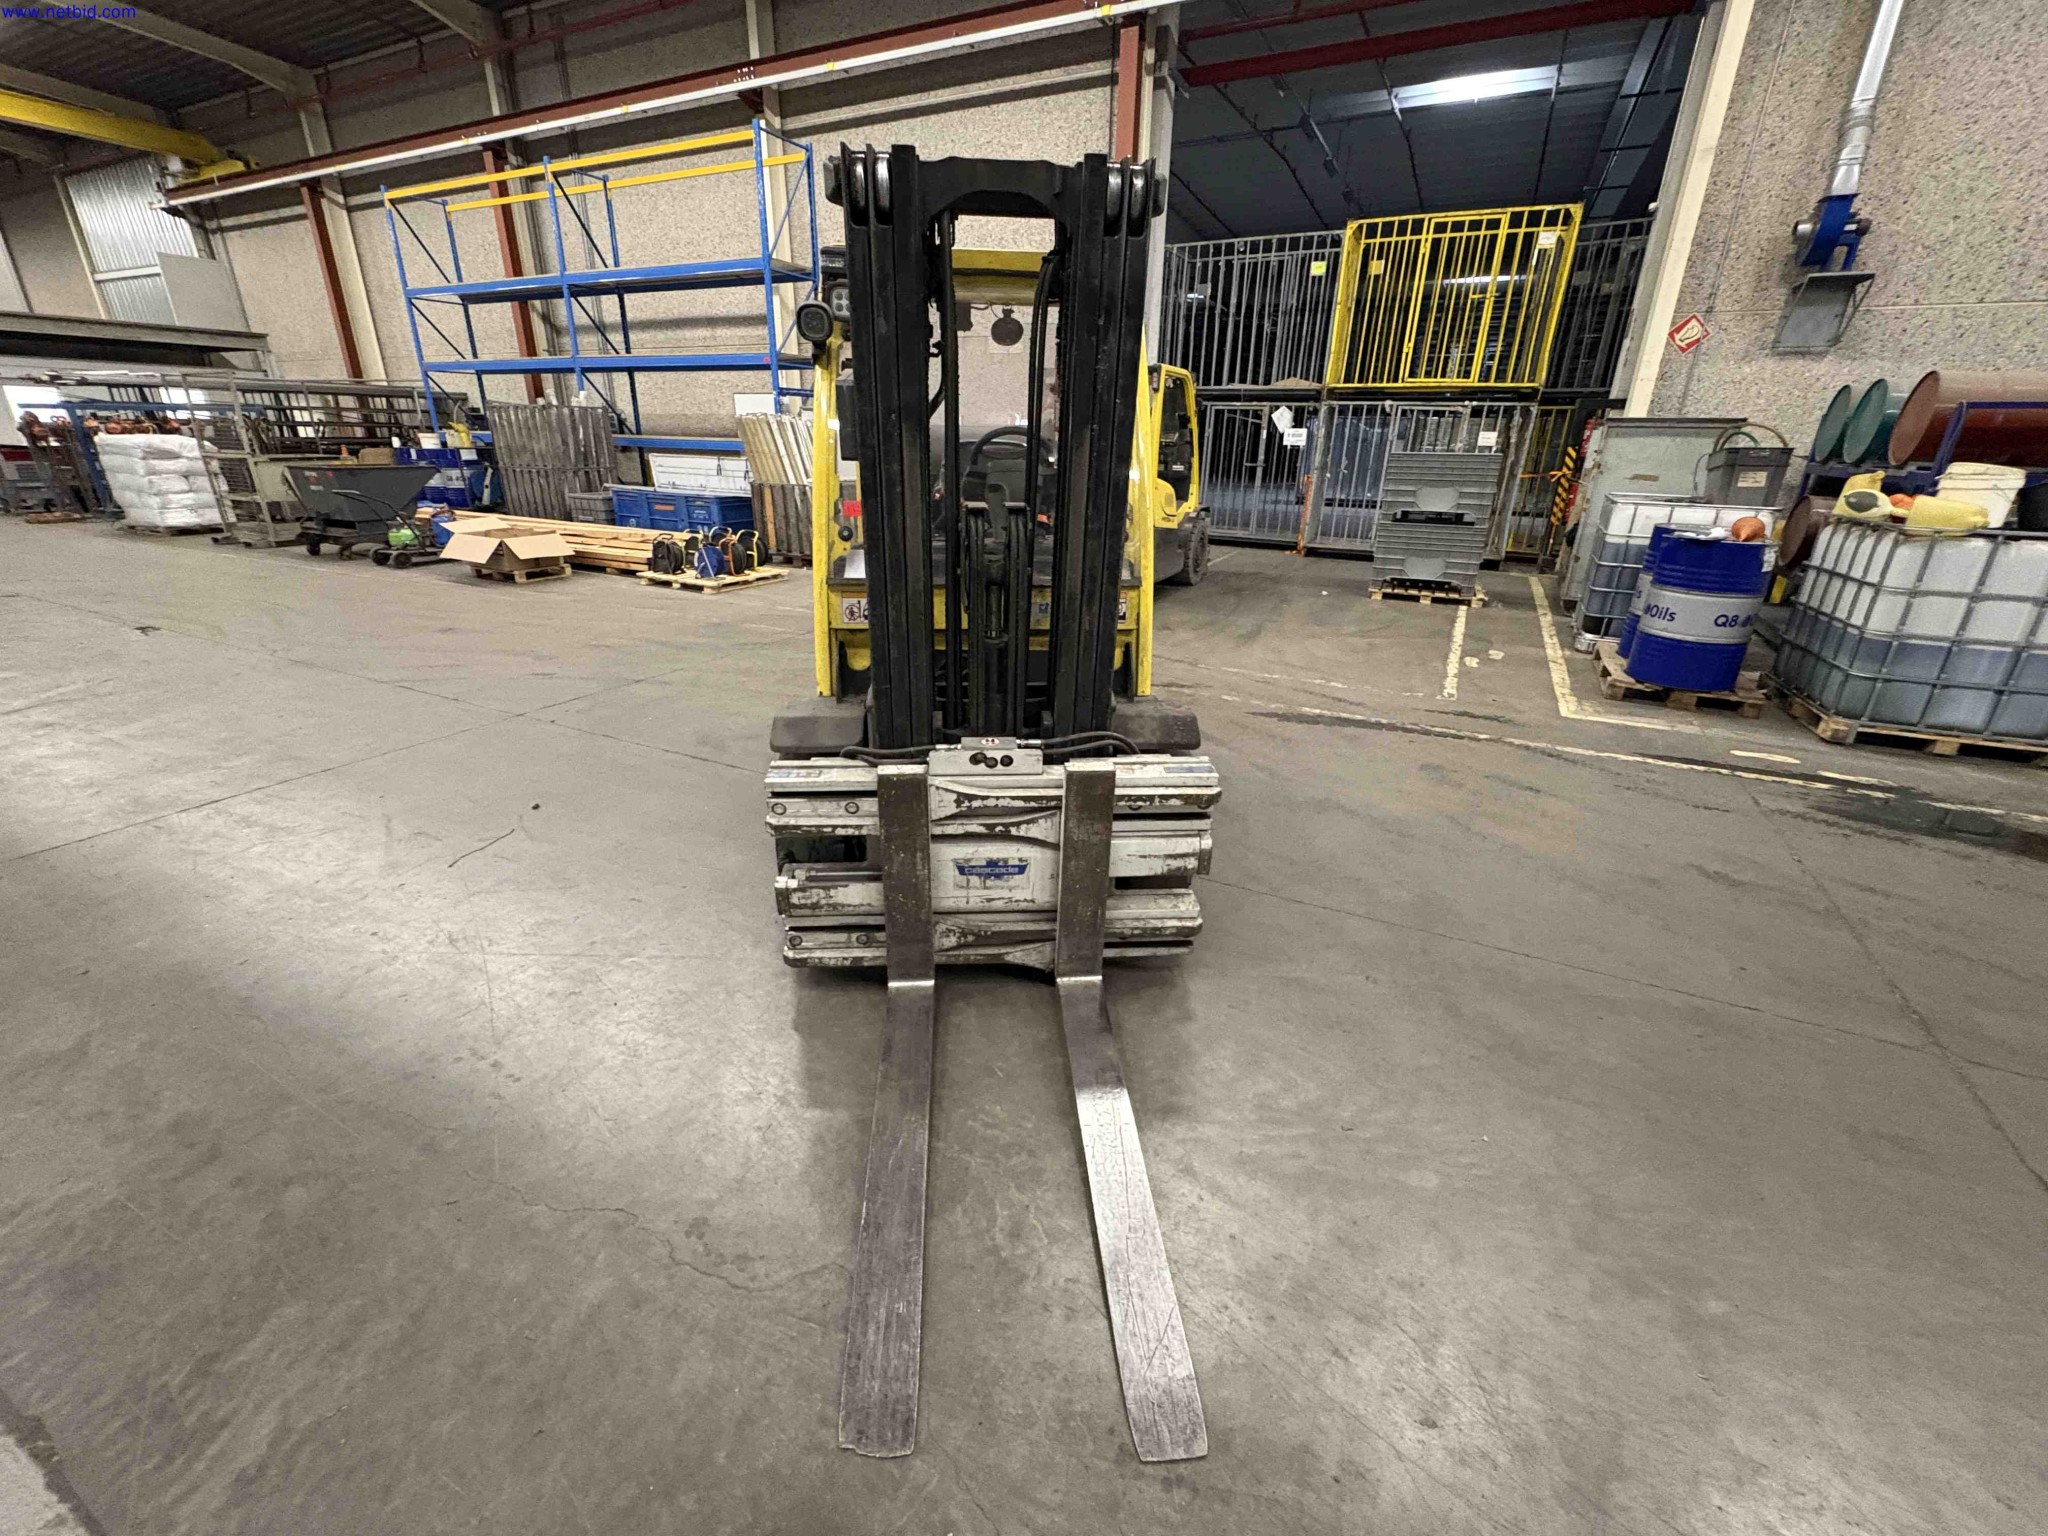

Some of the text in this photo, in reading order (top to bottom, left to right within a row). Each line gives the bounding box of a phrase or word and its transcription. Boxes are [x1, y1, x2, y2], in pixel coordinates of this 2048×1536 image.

[1650, 604, 1677, 622] Oils
[1714, 613, 1739, 628] Q8
[964, 866, 1019, 875] cascade
